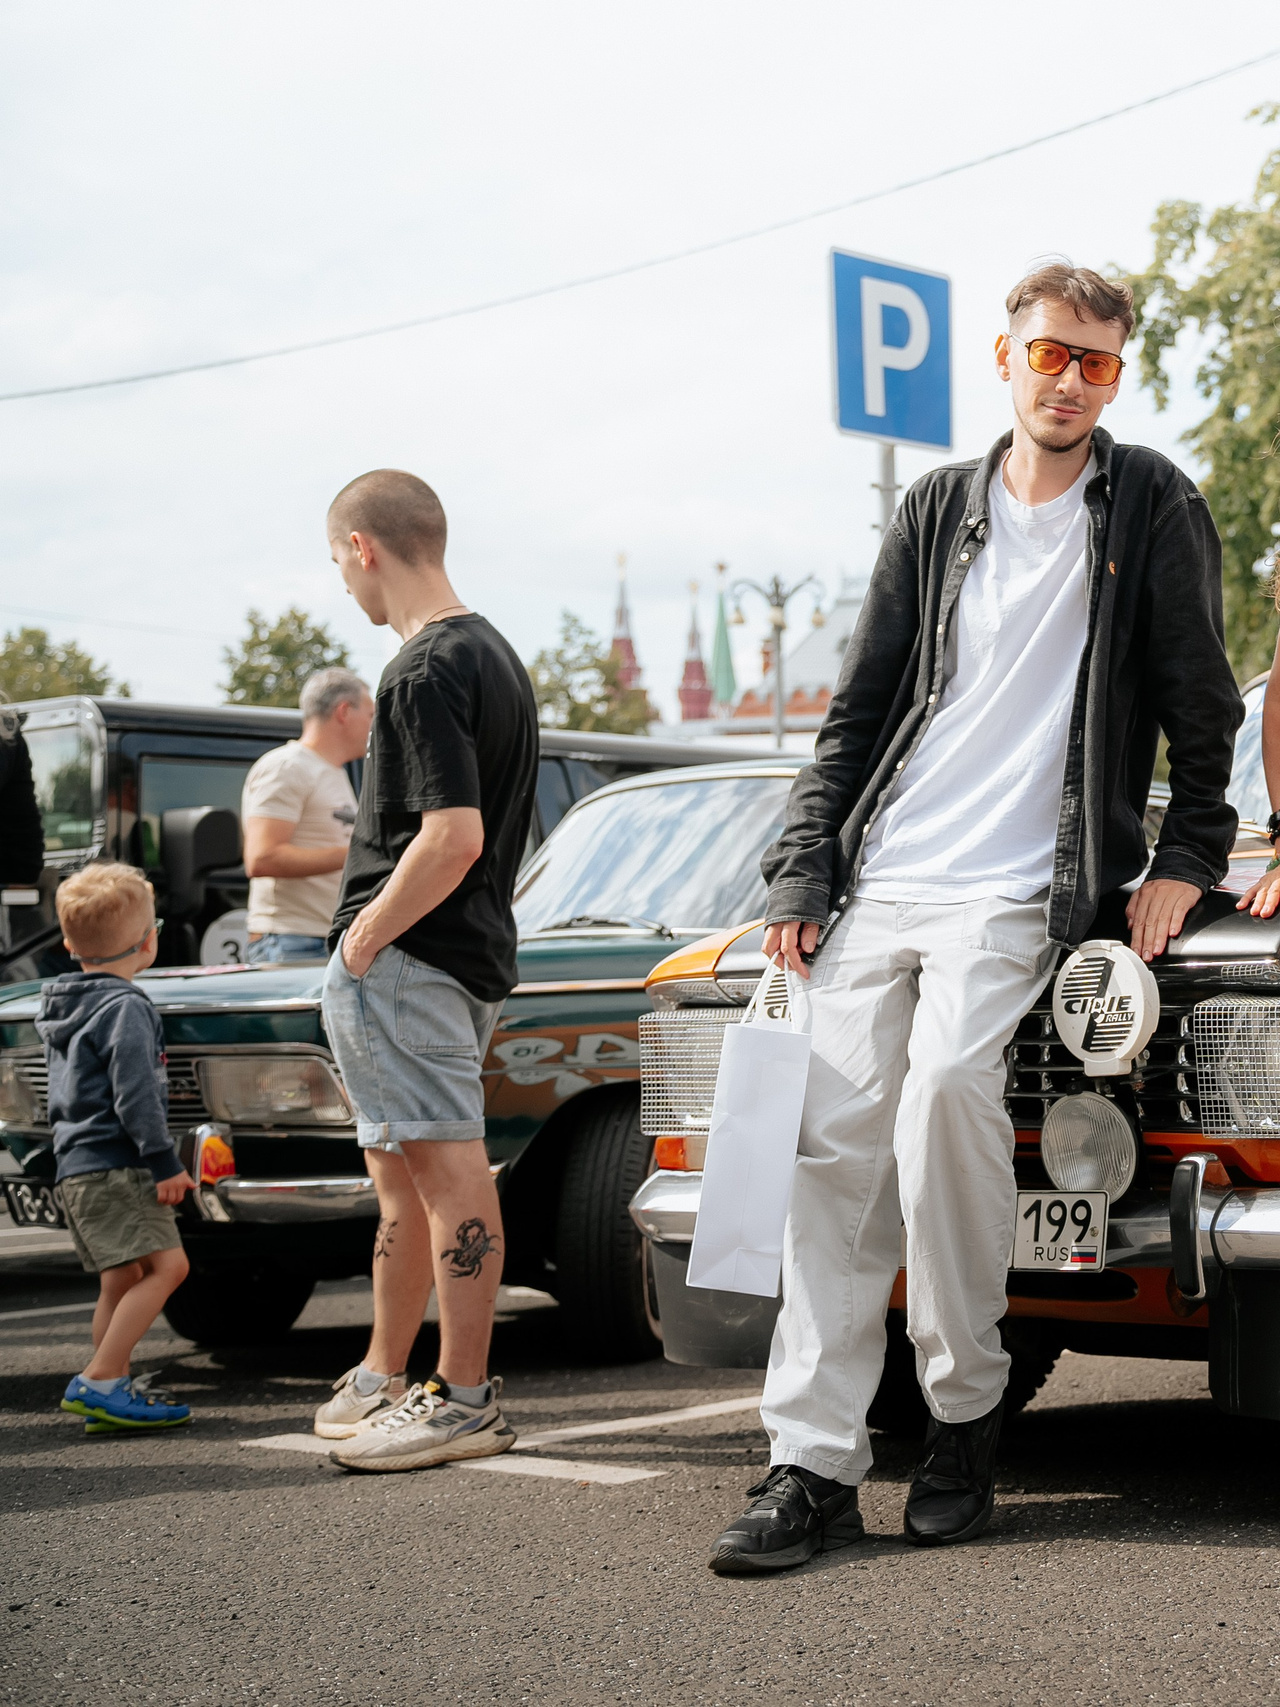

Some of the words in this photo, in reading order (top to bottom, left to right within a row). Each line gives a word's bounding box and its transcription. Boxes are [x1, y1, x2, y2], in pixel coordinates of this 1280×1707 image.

[860, 275, 931, 418] P
[1105, 1012, 1134, 1023] RALLY
[1022, 1199, 1093, 1243] 199
[1034, 1246, 1069, 1262] RUS
